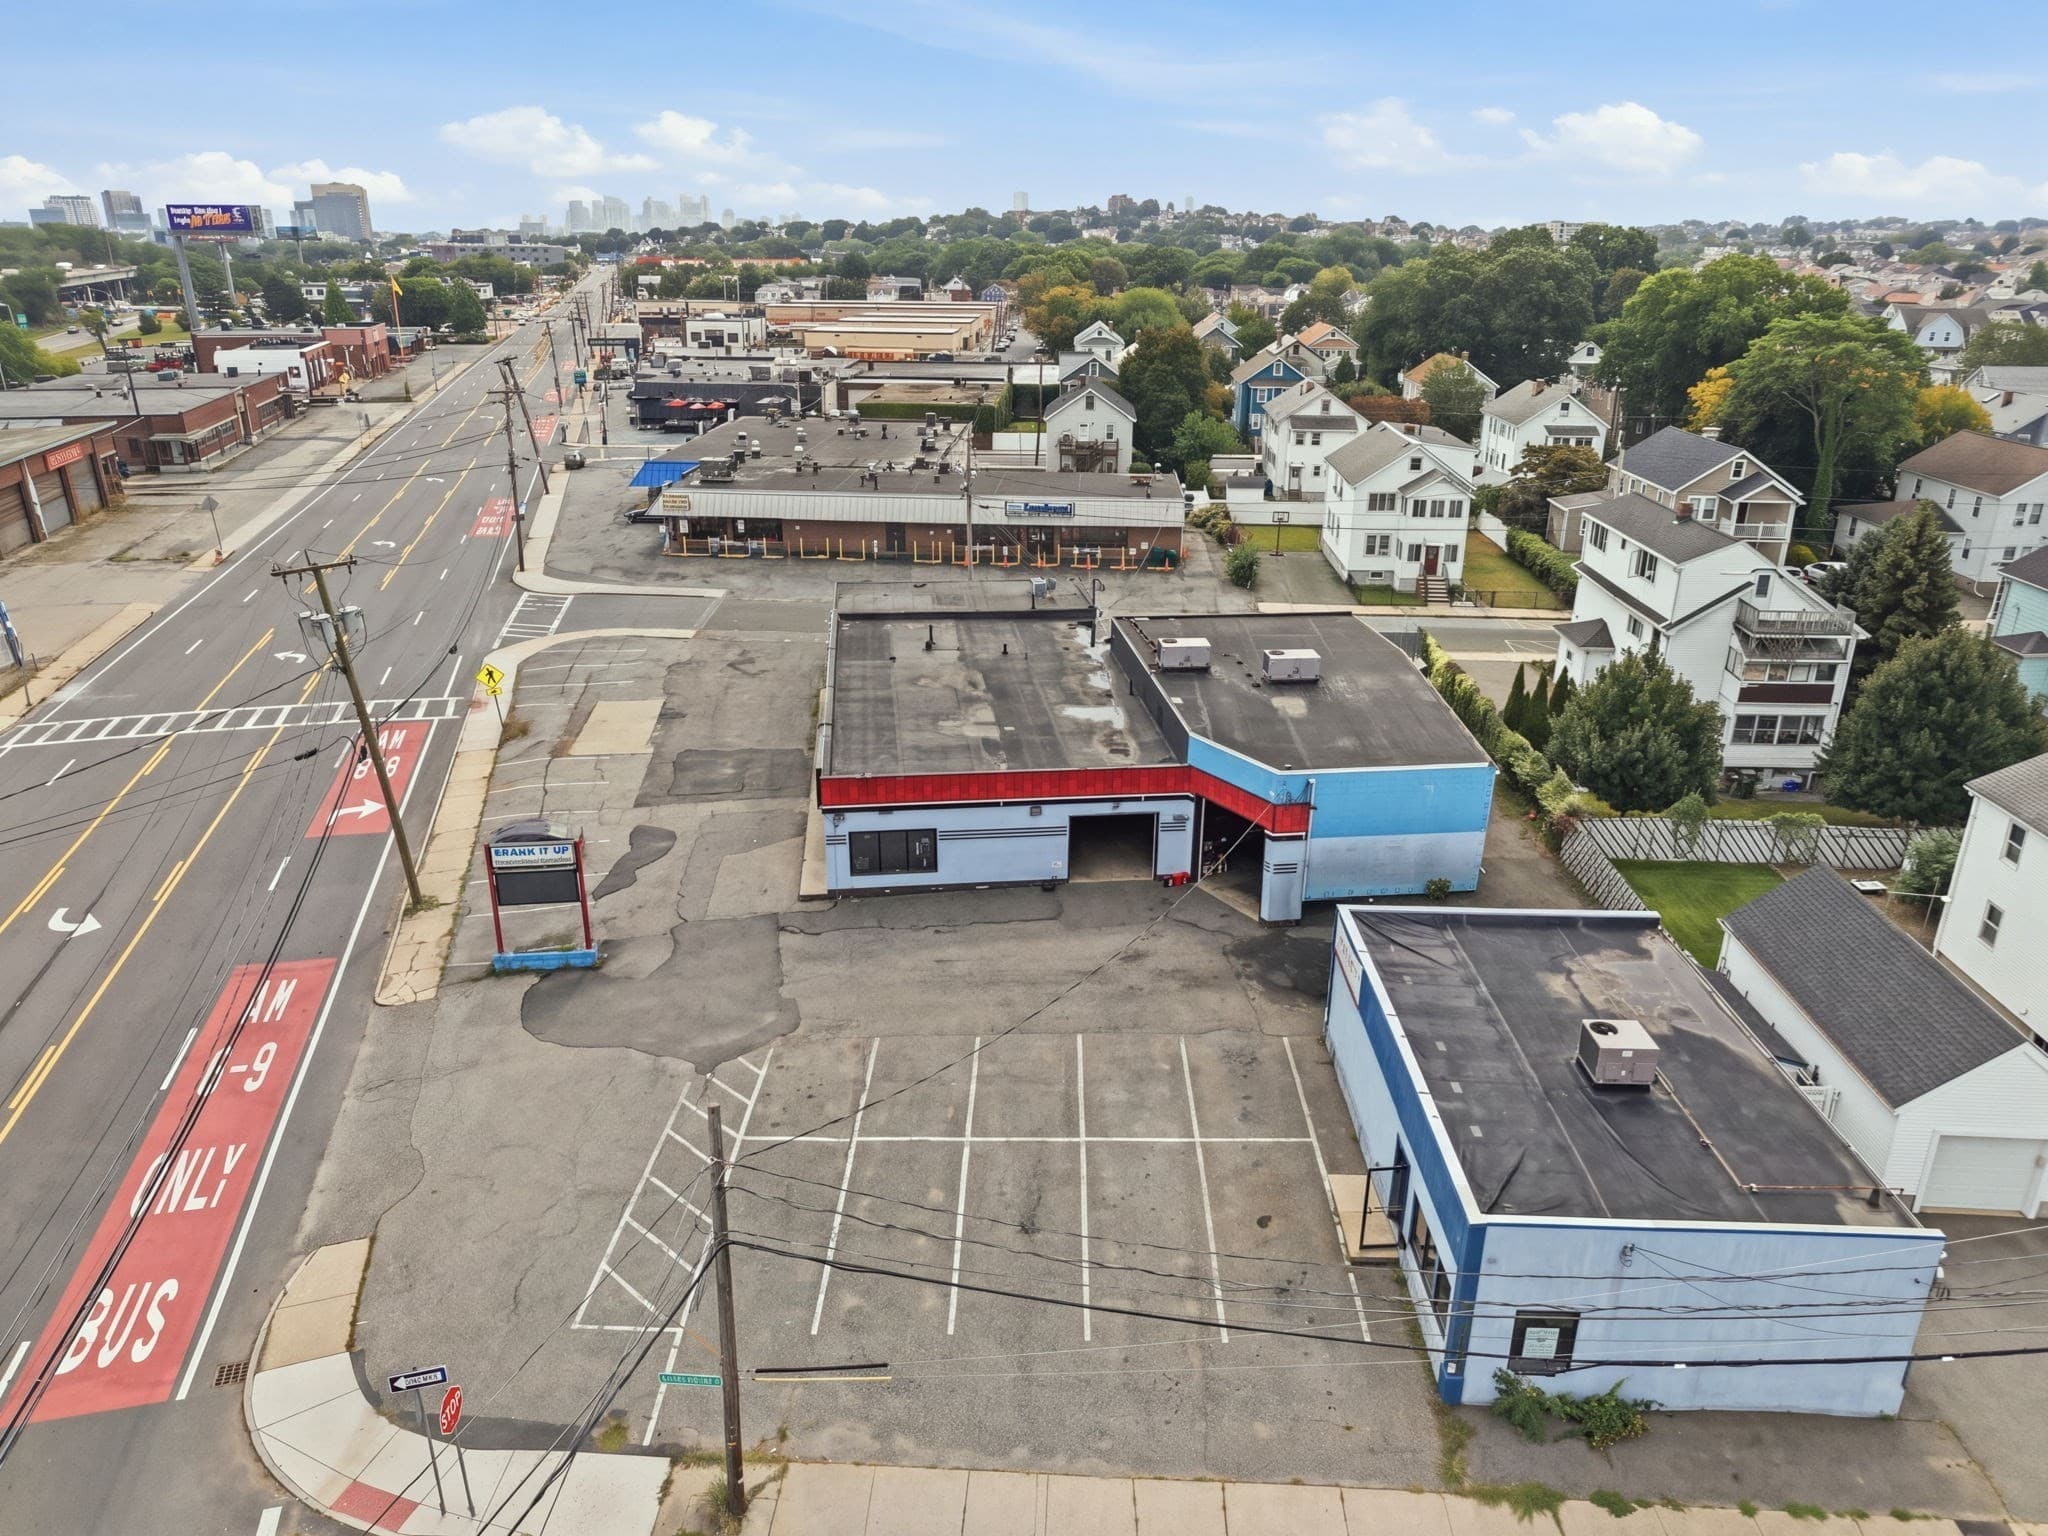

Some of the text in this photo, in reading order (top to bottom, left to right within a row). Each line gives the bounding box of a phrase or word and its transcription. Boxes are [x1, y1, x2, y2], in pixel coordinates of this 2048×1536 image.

[378, 729, 407, 750] AM
[539, 847, 549, 855] IT
[553, 846, 569, 855] UP
[241, 978, 298, 1024] AM
[130, 1143, 247, 1218] ONLY
[54, 1278, 179, 1375] BUS
[441, 1391, 461, 1430] STOP
